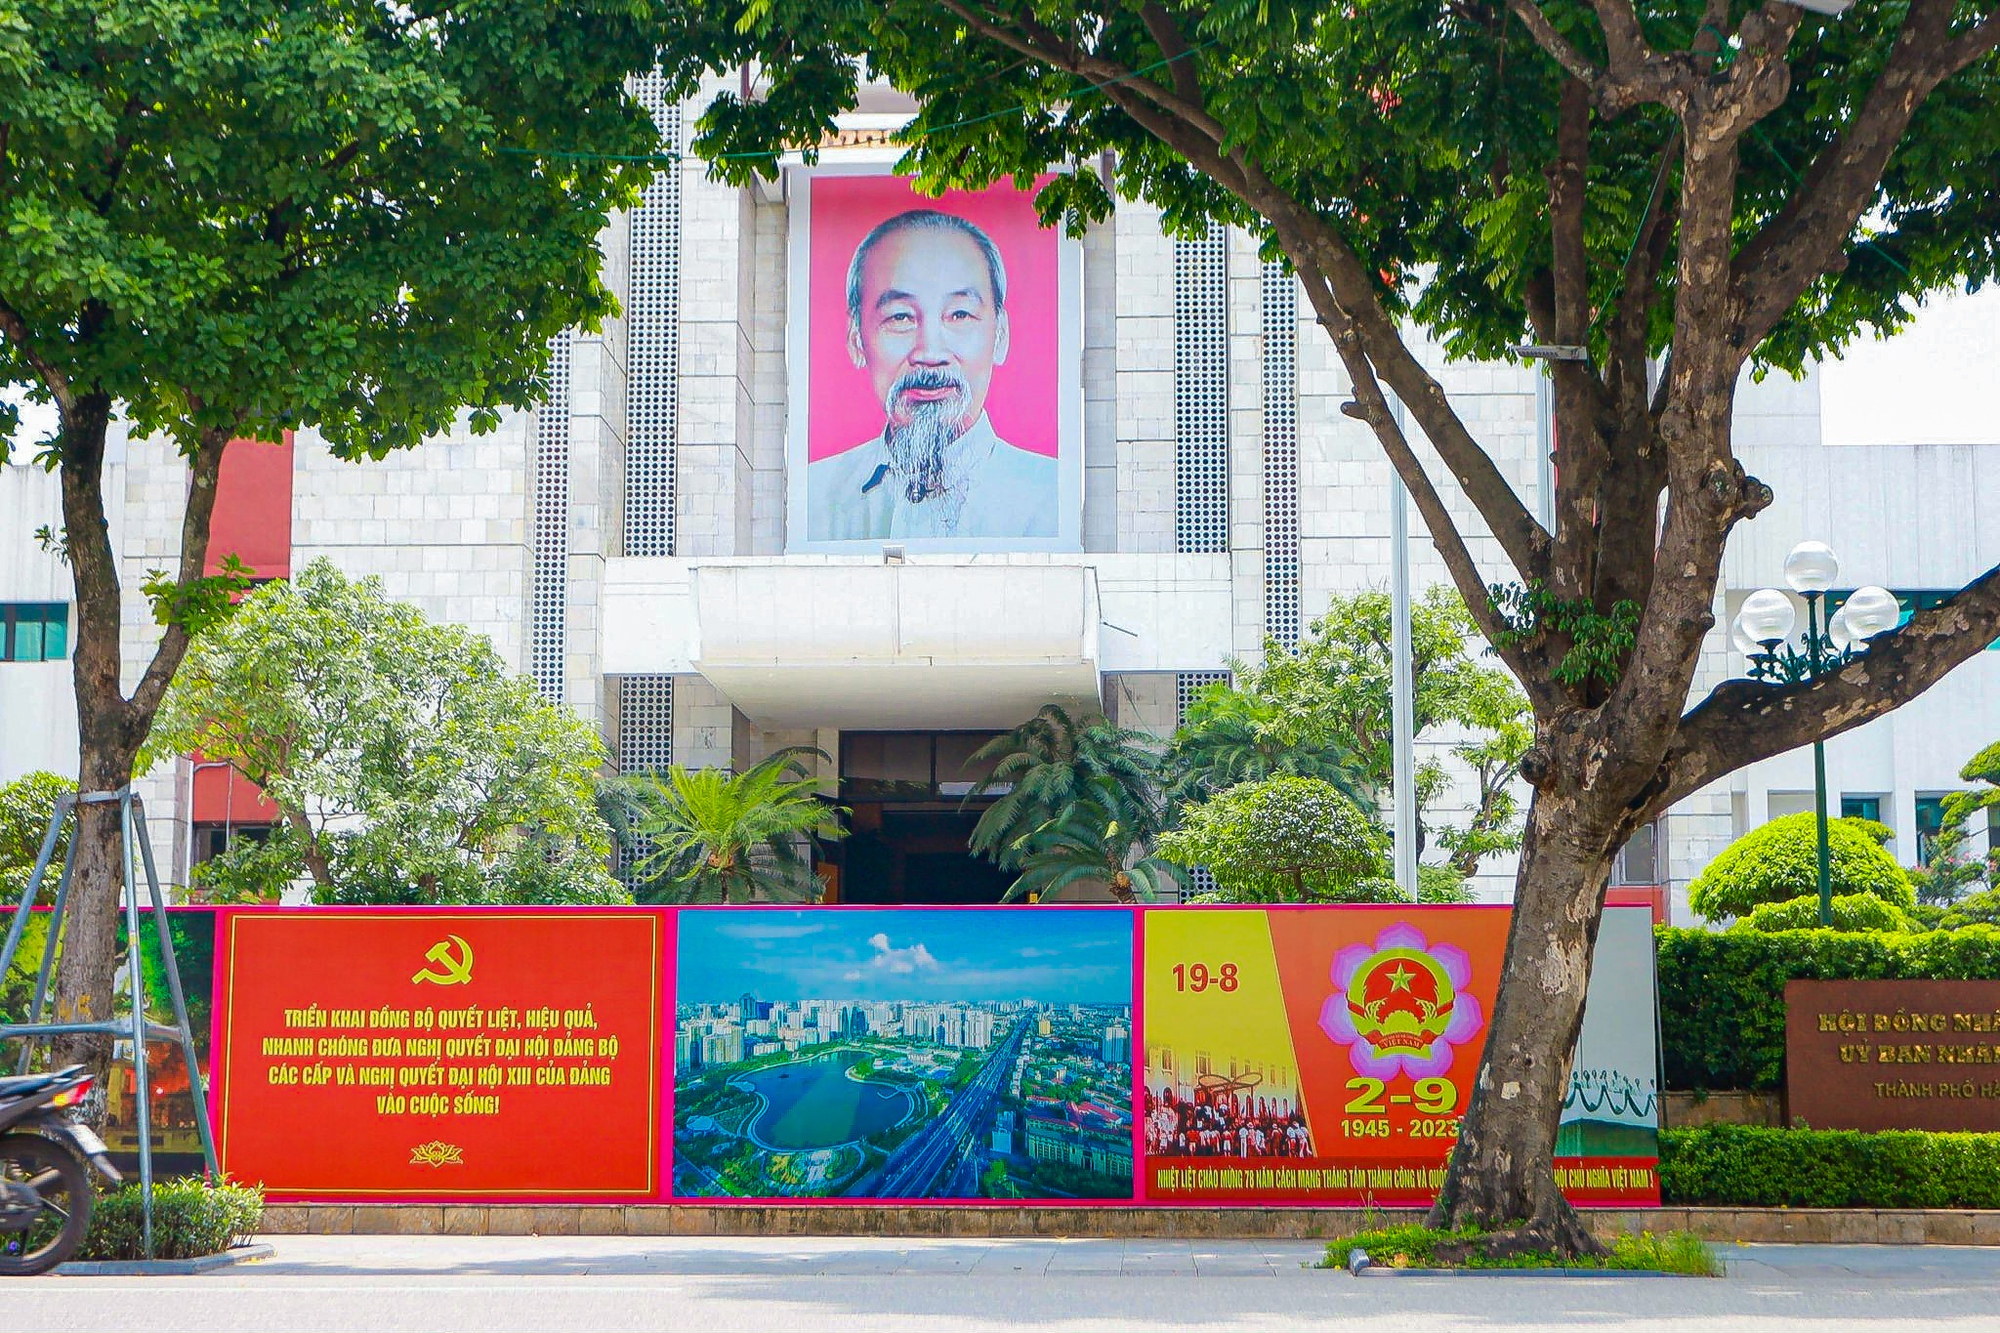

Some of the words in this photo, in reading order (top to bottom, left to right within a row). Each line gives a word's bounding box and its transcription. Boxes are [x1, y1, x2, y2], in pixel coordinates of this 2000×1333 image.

[1172, 962, 1239, 993] 19-8
[284, 1003, 327, 1028] TRIỂN
[330, 1009, 366, 1028] KHAI
[369, 1004, 410, 1028] ĐỒNG
[413, 1007, 434, 1031] BỘ
[438, 1003, 484, 1030] QUYẾT
[487, 1006, 522, 1031] LIỆT,
[525, 1006, 560, 1031] HIỆU
[564, 1002, 599, 1030] QUẢ,
[1818, 1008, 1867, 1037] HỘI
[262, 1037, 314, 1056] NHANH
[318, 1034, 368, 1057] CHÓNG
[372, 1037, 402, 1057] ĐƯA
[405, 1038, 442, 1061] NGHỊ
[446, 1032, 492, 1059] QUYẾT
[495, 1038, 520, 1060] ĐẠI
[524, 1034, 549, 1060] HỘI
[553, 1031, 594, 1057] ĐẢNG
[598, 1035, 619, 1060] BỘ
[1878, 1044, 1931, 1063] BAN
[268, 1062, 299, 1085] CÁC
[302, 1060, 333, 1085] CẤP
[336, 1063, 355, 1085] VÀ
[359, 1067, 395, 1089] NGHỊ
[399, 1060, 445, 1087] QUYẾT
[448, 1067, 473, 1089] ĐẠI
[477, 1063, 502, 1089] HỘI
[506, 1067, 532, 1086] XIII
[535, 1060, 566, 1086] CỦA
[569, 1060, 611, 1086] ĐẢNG
[1874, 1079, 1933, 1098] THÀNH
[1939, 1077, 1975, 1098] PHỐ
[376, 1092, 406, 1114] VÀO
[409, 1092, 449, 1117] CUỘC
[453, 1090, 500, 1114] SỐNG!
[1344, 1077, 1458, 1114] 2-9
[1341, 1119, 1390, 1138] 1945
[1409, 1119, 1459, 1138] 2023
[1157, 1165, 1179, 1192] NHIỆT
[1181, 1165, 1196, 1192] LIỆT
[1198, 1165, 1218, 1188] CHÀO
[1244, 1169, 1254, 1188] 78
[1256, 1165, 1274, 1188] NĂM
[1275, 1165, 1297, 1188] CÁCH
[1298, 1168, 1320, 1193] MẠNG
[1322, 1165, 1348, 1188] THÁNG
[1349, 1165, 1366, 1188] TÁM
[1367, 1165, 1393, 1188] THÀNH
[1394, 1165, 1415, 1188] CÔNG
[1417, 1165, 1428, 1188] VÀ
[1569, 1160, 1585, 1188] CHỦ
[1611, 1165, 1628, 1194] VIỆT
[1629, 1169, 1648, 1188] NAM
